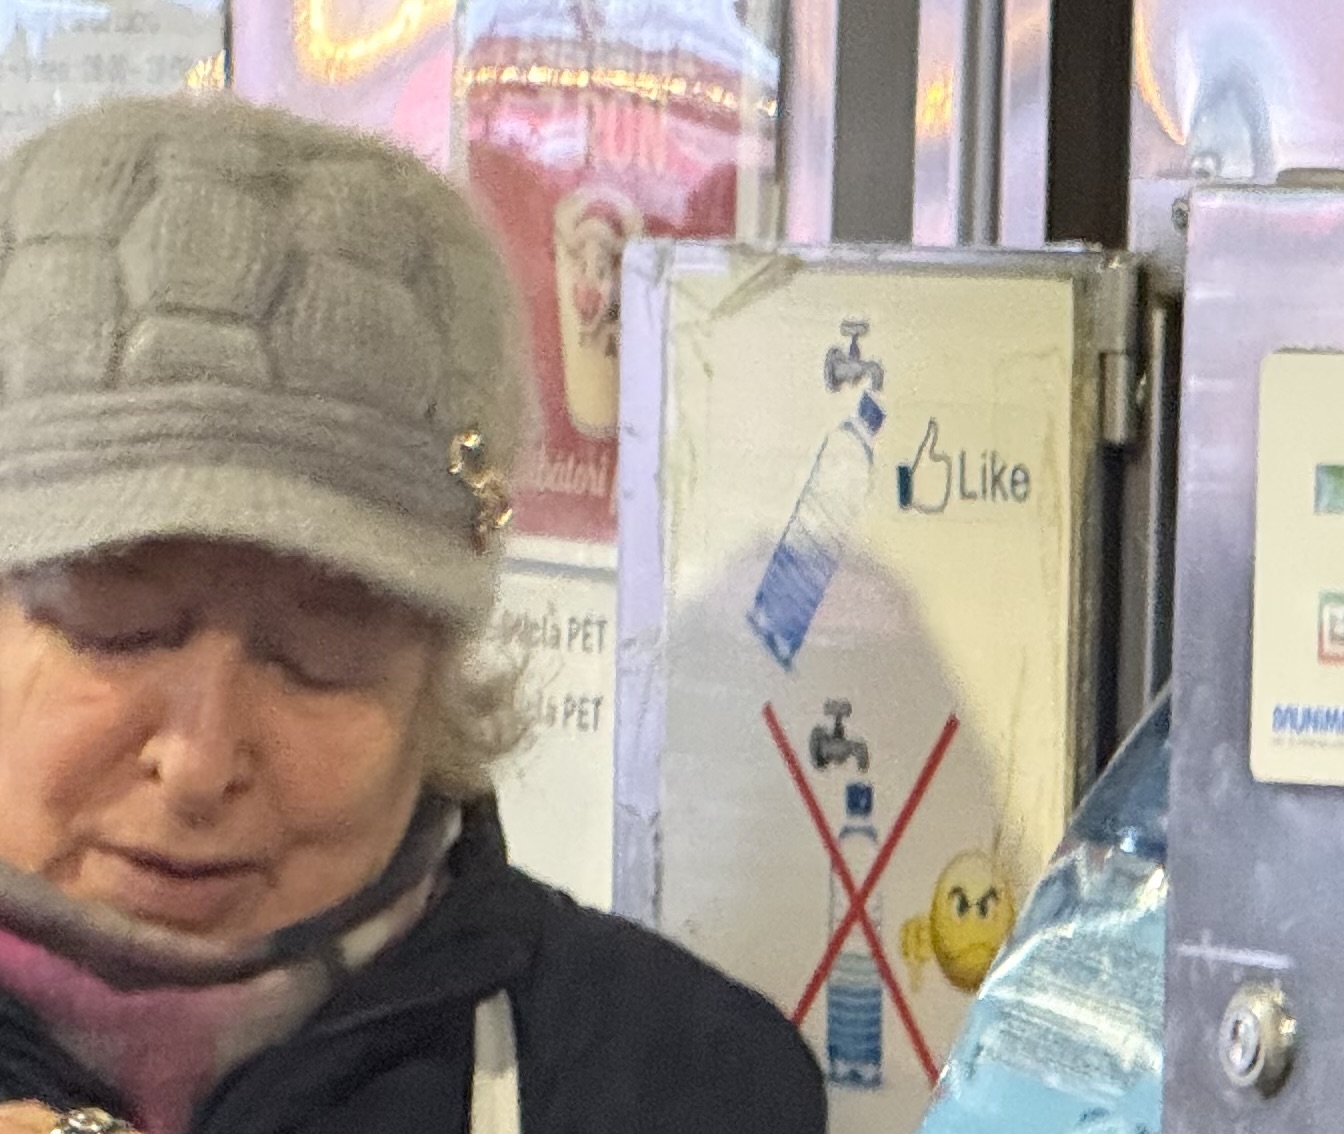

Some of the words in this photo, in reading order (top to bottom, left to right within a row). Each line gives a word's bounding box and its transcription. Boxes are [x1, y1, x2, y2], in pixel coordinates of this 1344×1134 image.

[959, 448, 1030, 504] Like
[566, 615, 607, 654] PET
[562, 693, 604, 732] PET
